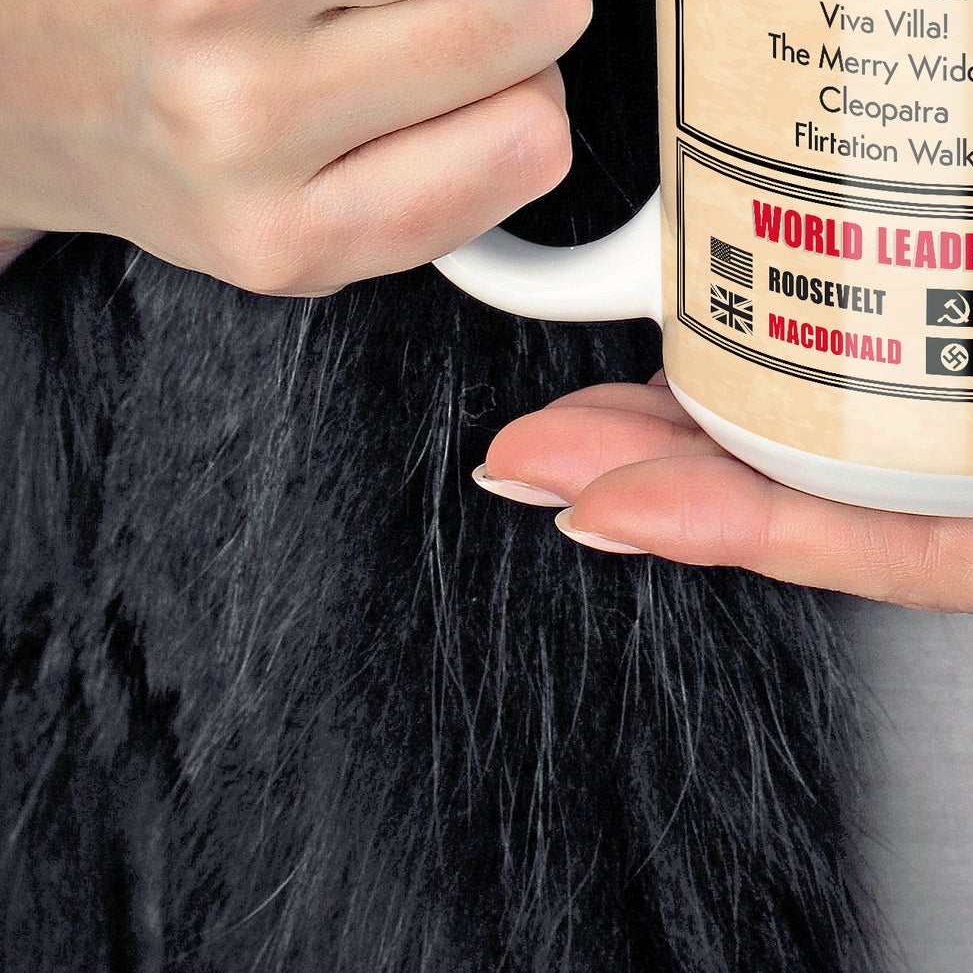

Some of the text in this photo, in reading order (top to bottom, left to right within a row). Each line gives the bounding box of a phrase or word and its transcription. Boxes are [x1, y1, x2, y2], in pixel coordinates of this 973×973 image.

[819, 1, 949, 39] Viva Villa!
[768, 32, 811, 67] The
[818, 42, 899, 85] Merry
[819, 85, 950, 128] Cleopatra
[794, 122, 898, 163] Flirtation
[752, 199, 863, 261] WORLD
[768, 265, 887, 316] ROOSEVELT
[768, 312, 903, 366] MACDONALD
